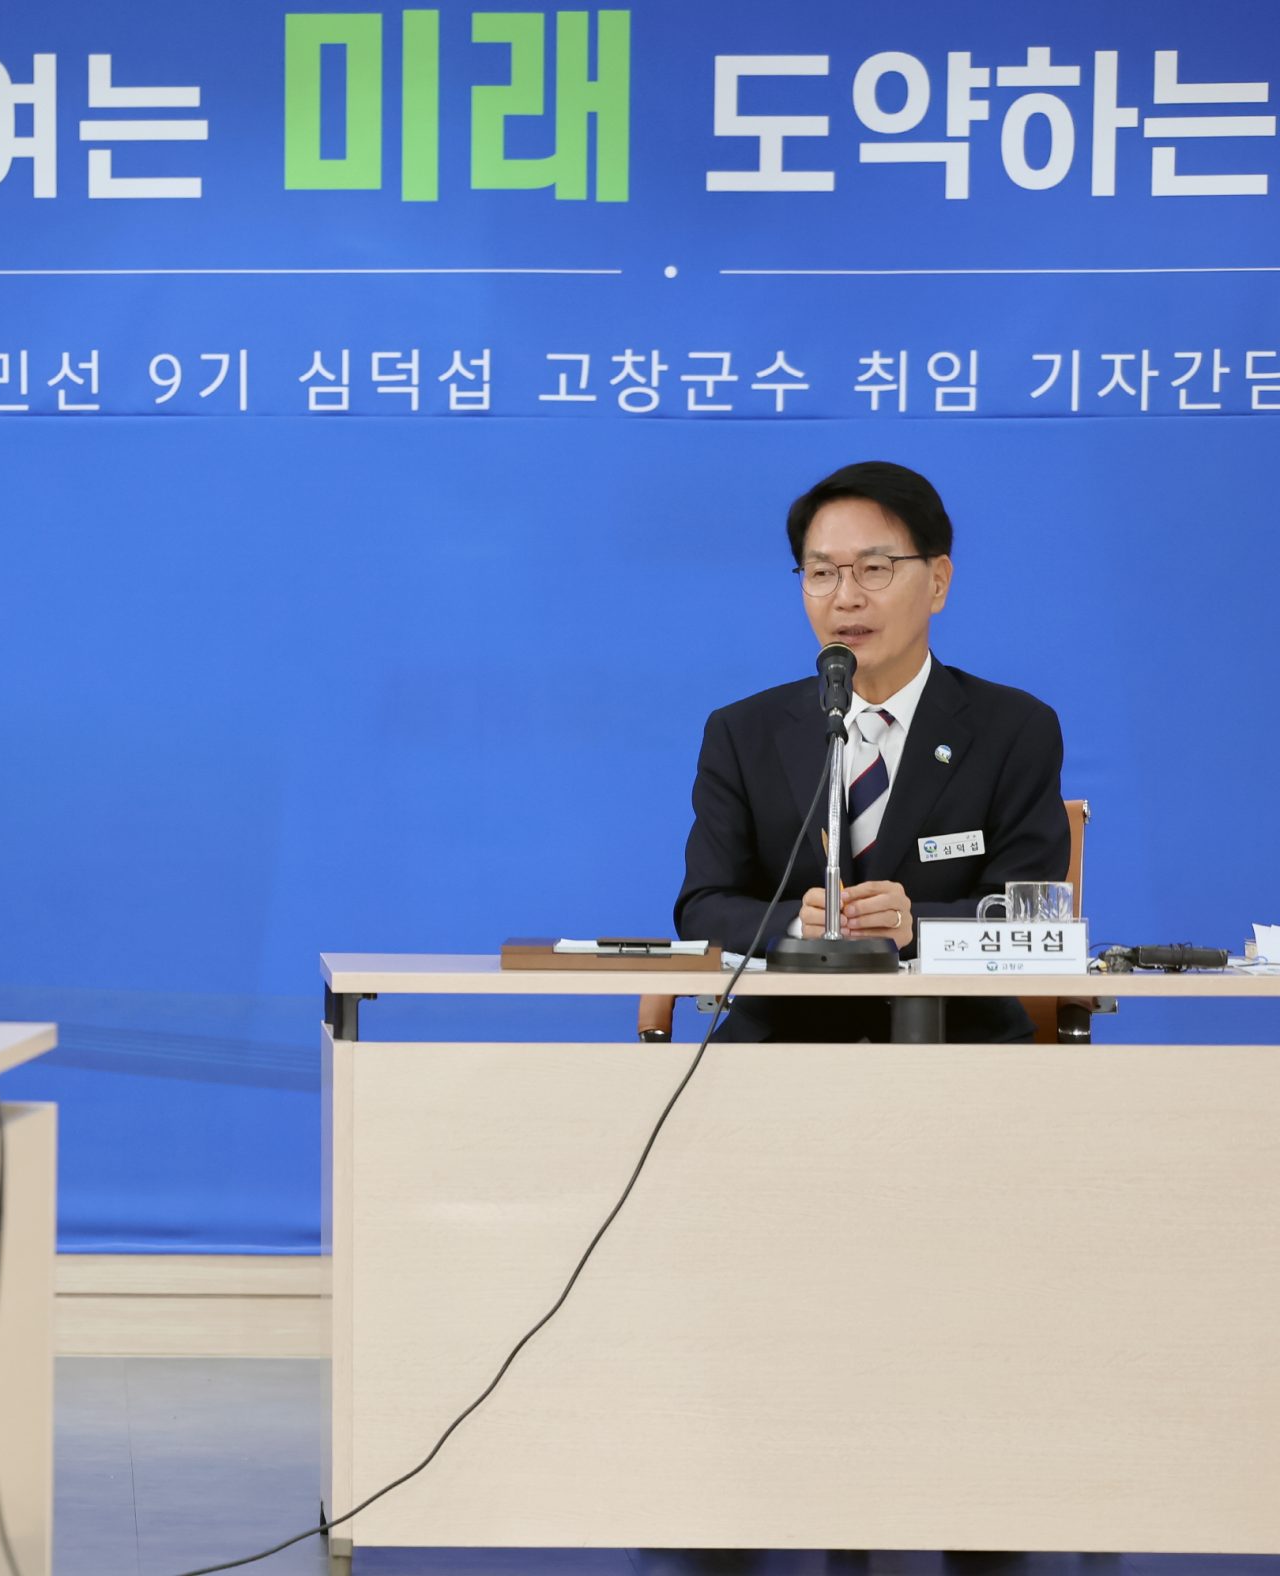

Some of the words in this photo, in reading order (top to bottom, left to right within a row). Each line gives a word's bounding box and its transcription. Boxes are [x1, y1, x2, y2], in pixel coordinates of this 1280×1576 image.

[284, 9, 631, 201] 미래
[706, 46, 1277, 200] 도약하는
[149, 349, 247, 411] 9기
[298, 348, 491, 411] 심덕섭
[538, 348, 809, 412] 고창군수
[854, 349, 977, 412] 취임
[943, 939, 969, 952] 군수
[978, 930, 1064, 953] 심덕섭
